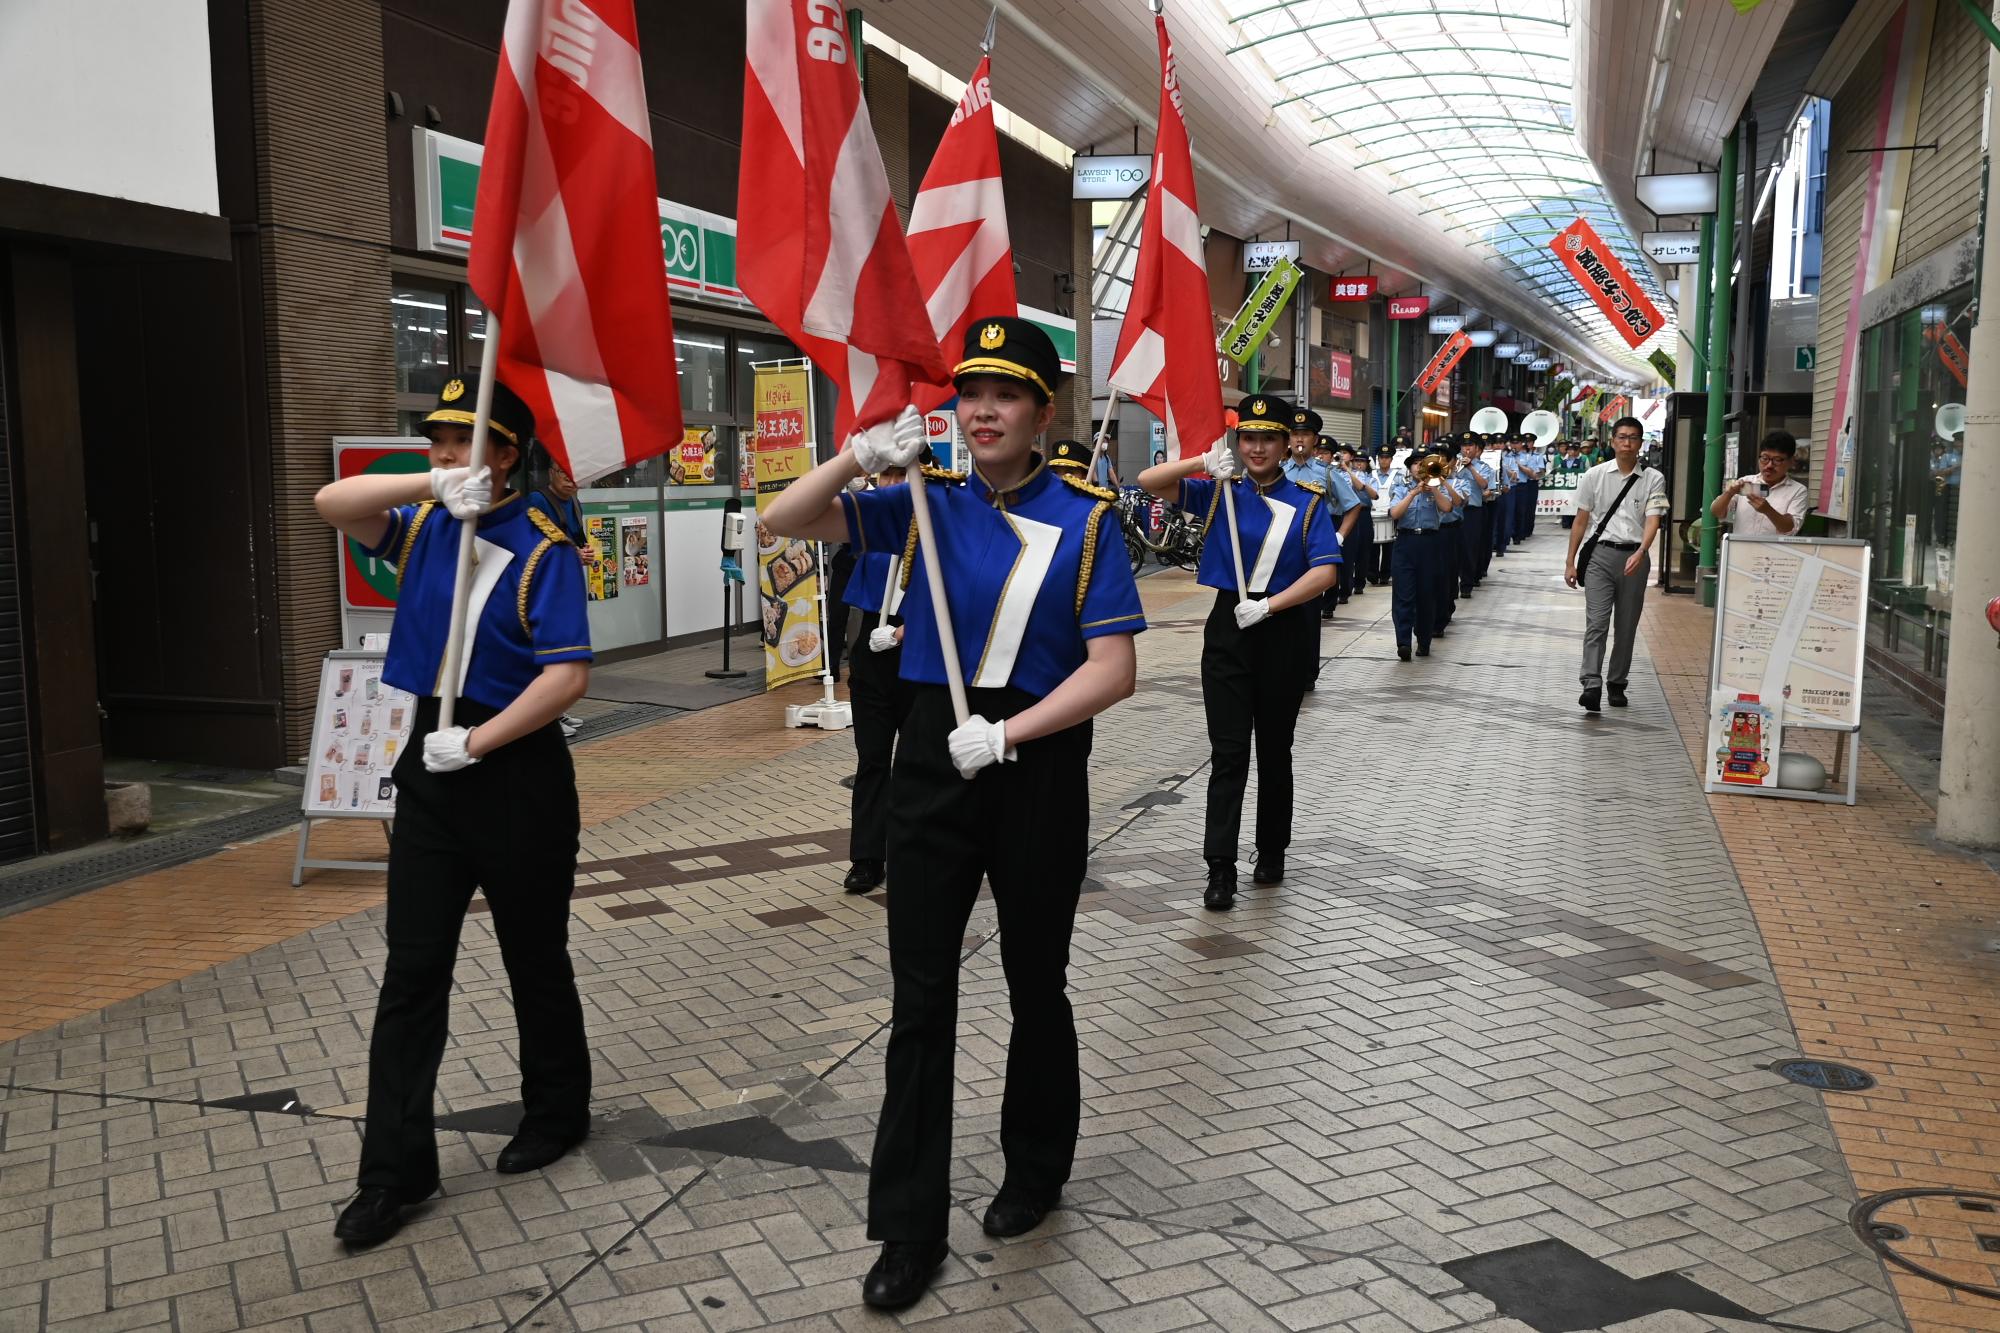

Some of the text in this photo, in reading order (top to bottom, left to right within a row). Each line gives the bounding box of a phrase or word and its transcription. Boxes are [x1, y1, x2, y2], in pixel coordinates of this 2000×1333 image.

[1077, 168, 1144, 182] LAWSON 100
[660, 223, 698, 272] 00
[1335, 283, 1369, 296] 美容室
[1391, 303, 1420, 315] READD
[1332, 361, 1350, 391] READD
[1801, 695, 1851, 707] STREET MAP
